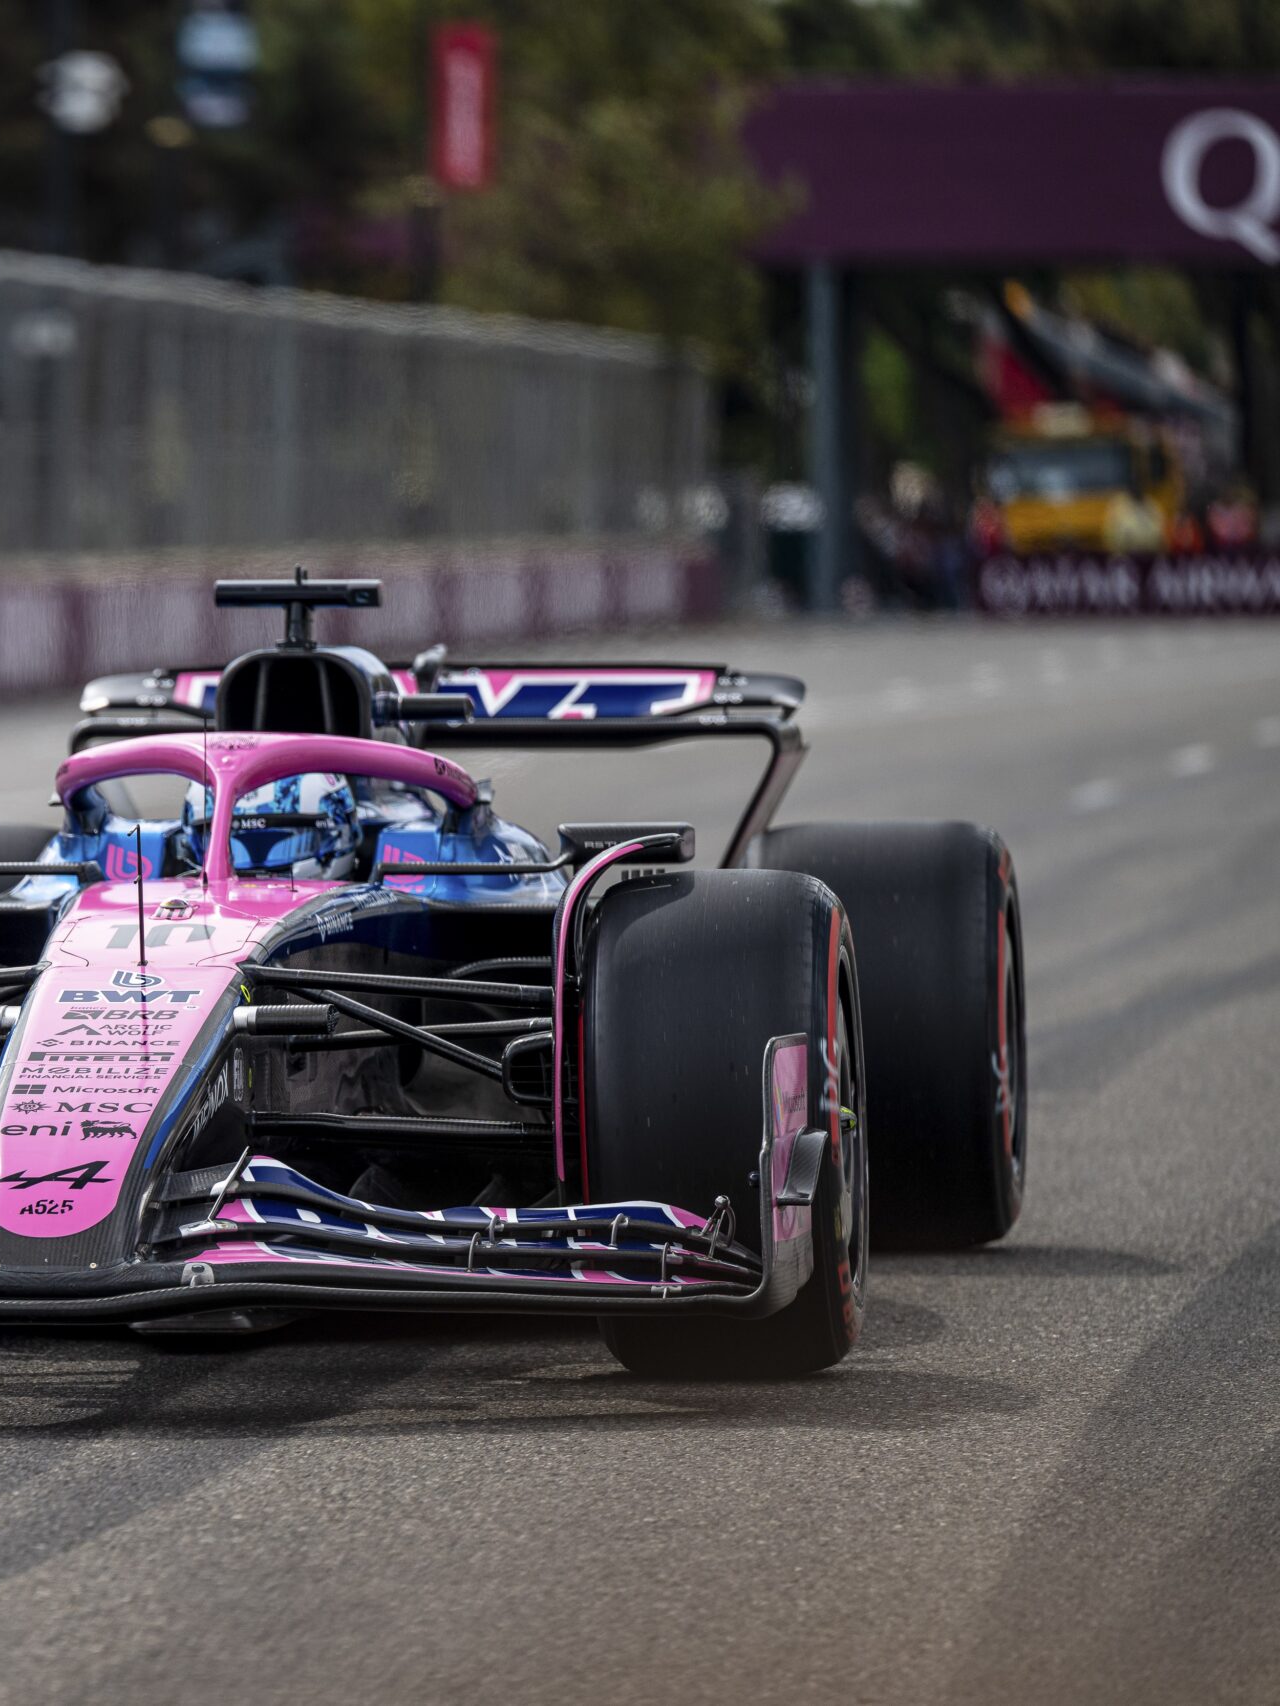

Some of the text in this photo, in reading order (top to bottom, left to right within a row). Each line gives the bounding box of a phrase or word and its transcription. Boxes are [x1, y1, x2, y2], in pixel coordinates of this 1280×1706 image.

[58, 989, 201, 1004] BWT
[102, 1009, 180, 1020] BRB
[27, 1051, 176, 1063] PIRELLI
[52, 1085, 161, 1095] Microsoft
[53, 1101, 154, 1114] MSC
[0, 1120, 73, 1137] eni
[19, 1199, 74, 1215] A525
